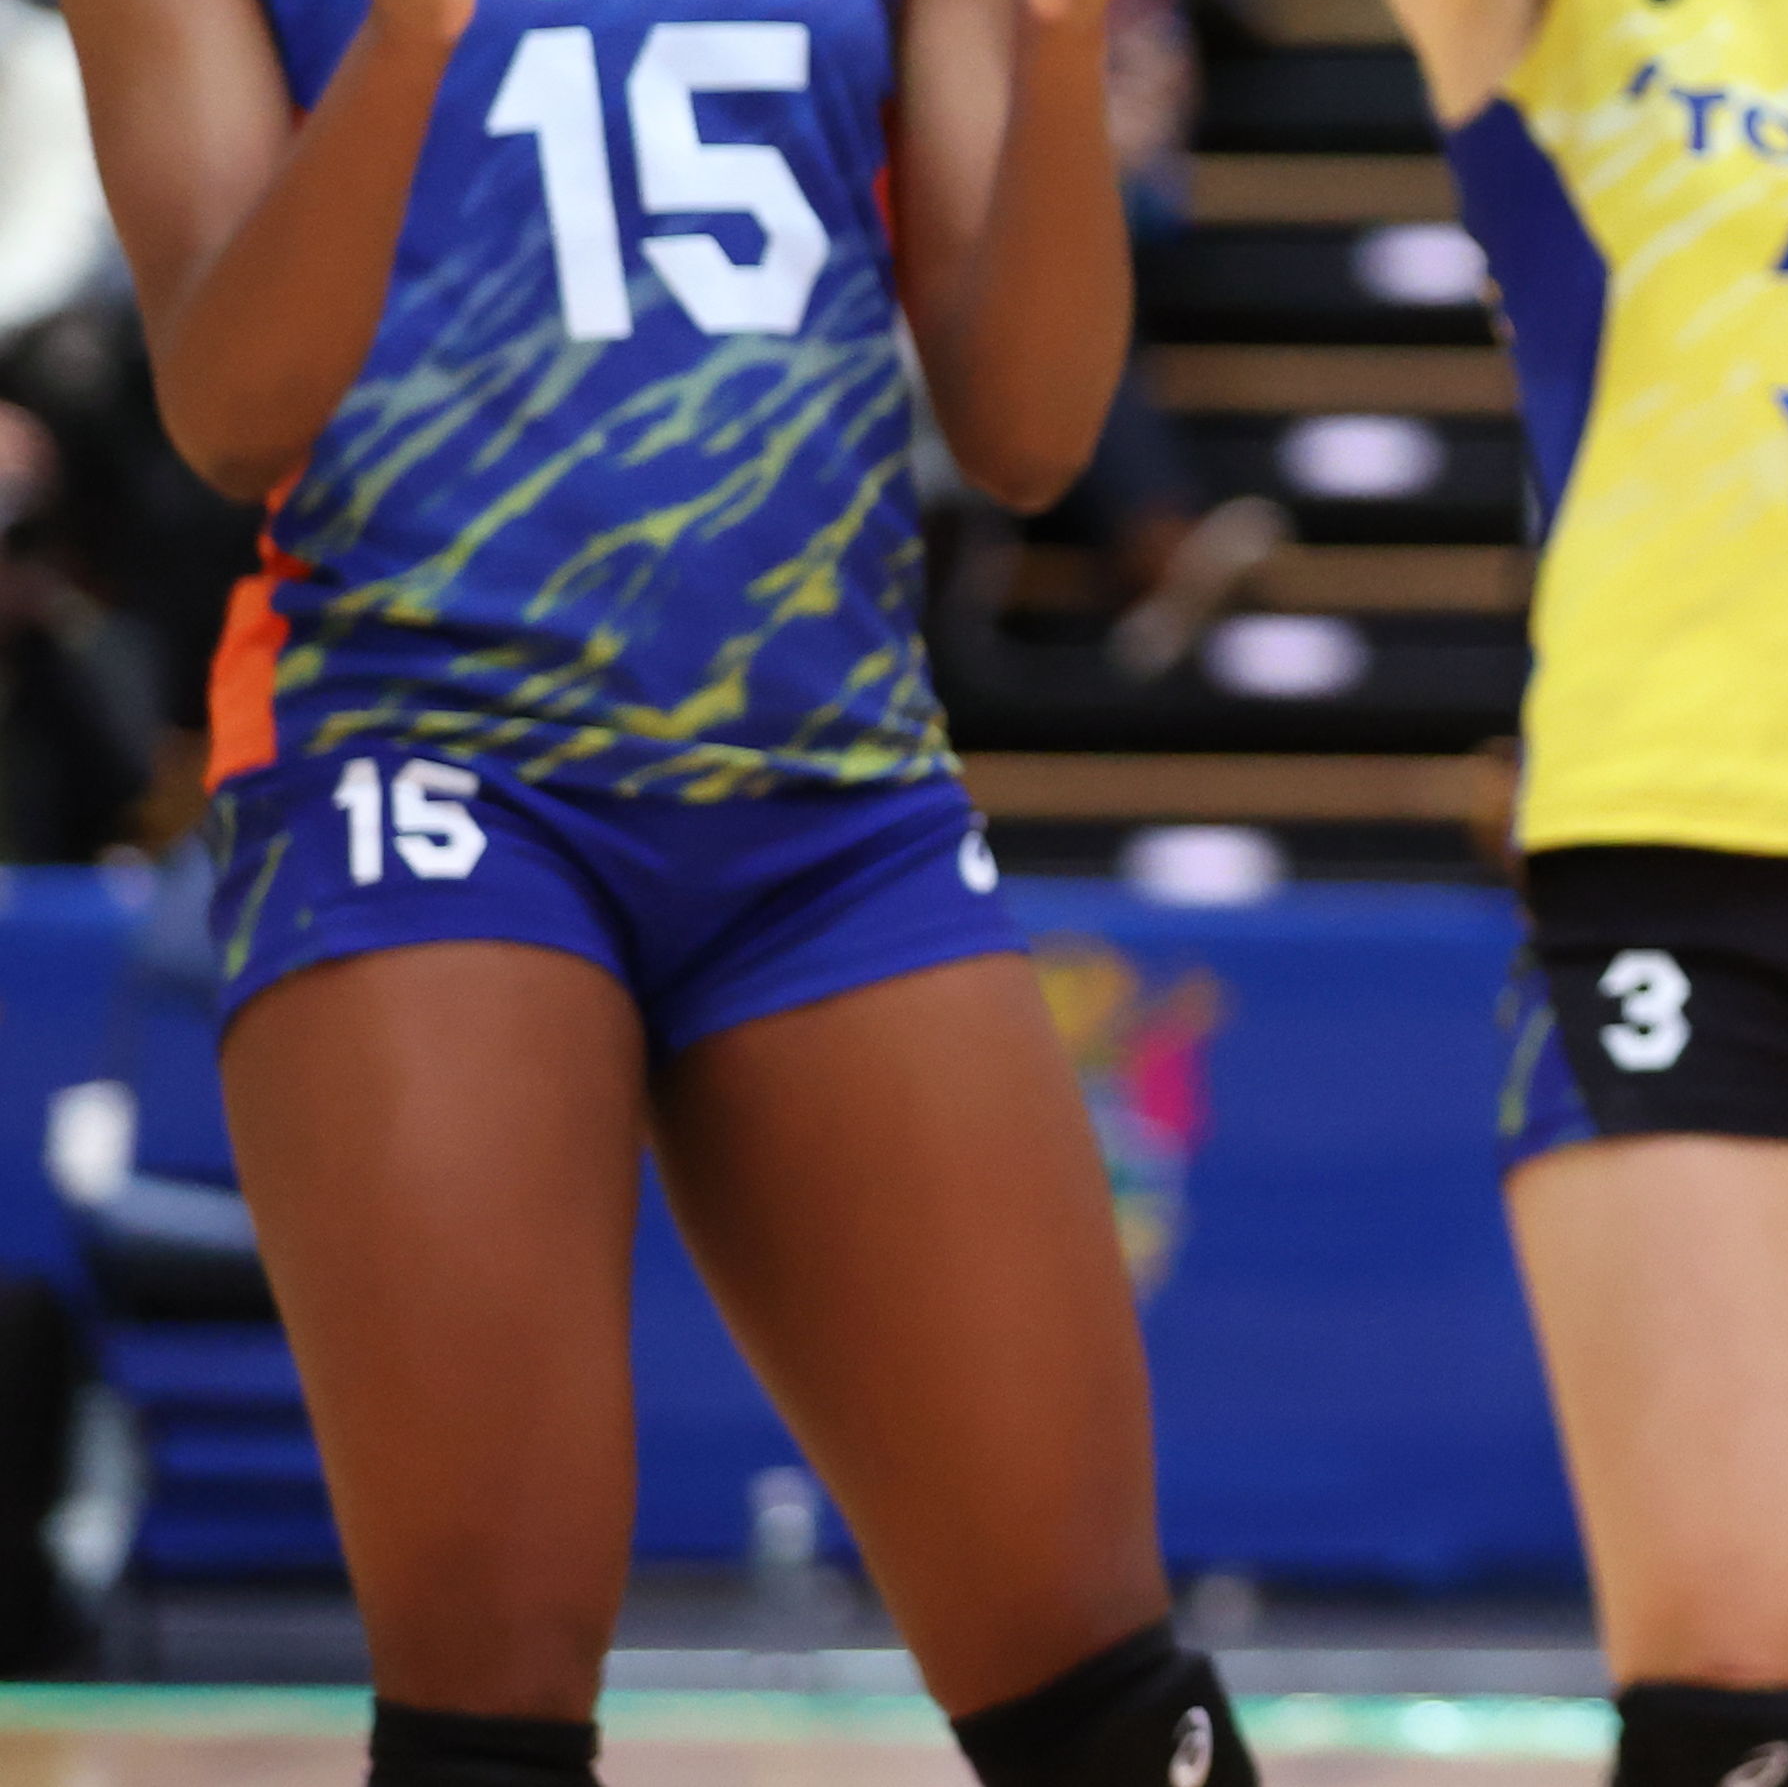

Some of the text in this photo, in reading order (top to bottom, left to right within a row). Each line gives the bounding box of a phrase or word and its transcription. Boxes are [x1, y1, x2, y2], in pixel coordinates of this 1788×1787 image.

[487, 22, 829, 341] 15
[333, 758, 487, 885] 15
[1599, 948, 1692, 1073] 3
